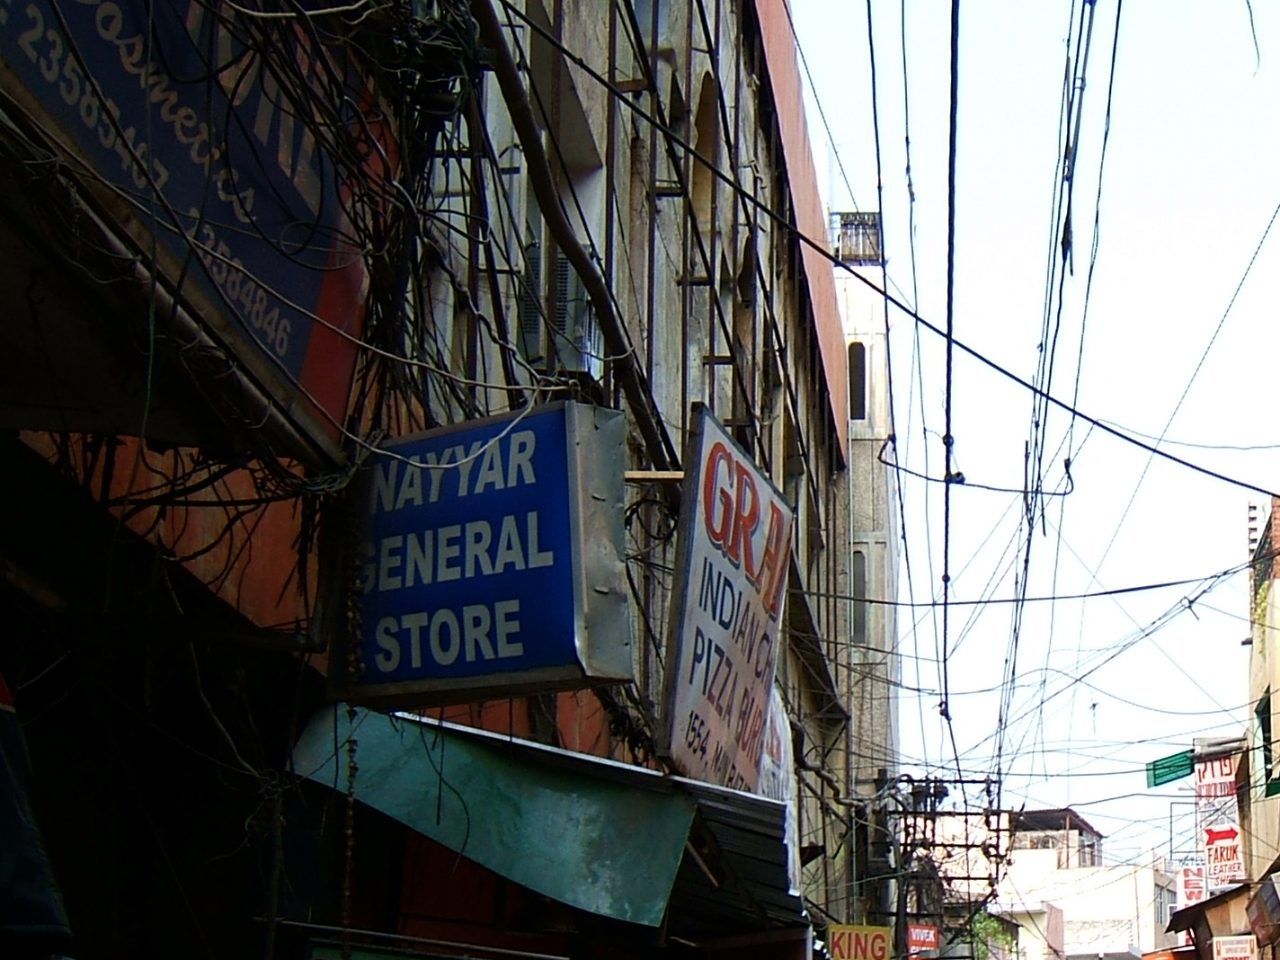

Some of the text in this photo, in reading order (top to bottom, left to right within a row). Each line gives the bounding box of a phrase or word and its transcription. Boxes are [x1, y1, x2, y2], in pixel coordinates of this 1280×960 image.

[97, 0, 256, 223] osmetics
[372, 429, 537, 516] NAYYAR
[374, 599, 524, 673] STORE
[699, 557, 759, 667] INDIAN
[689, 626, 737, 721] PIZZA
[1207, 844, 1239, 864] FARUK
[1209, 863, 1242, 876] LEATHER
[831, 932, 886, 960] KING
